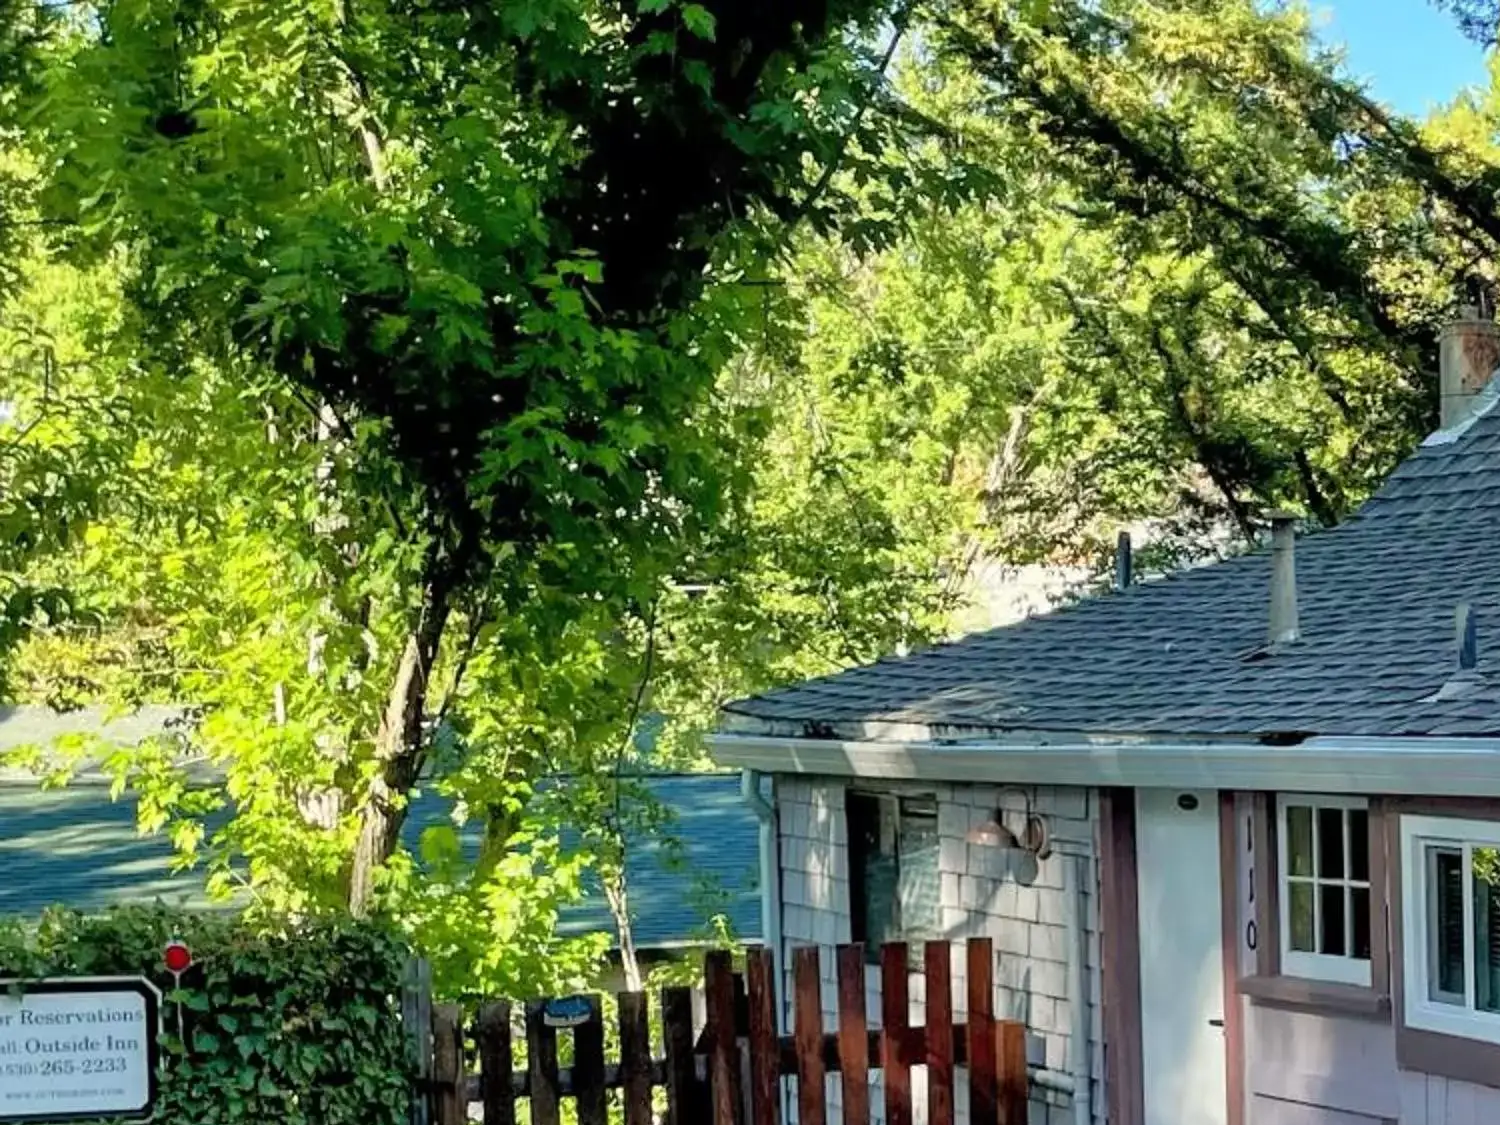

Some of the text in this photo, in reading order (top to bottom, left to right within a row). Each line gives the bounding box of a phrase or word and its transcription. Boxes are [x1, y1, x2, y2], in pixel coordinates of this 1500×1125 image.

[1246, 815, 1258, 950] 110
[20, 1008, 144, 1026] Reservations
[25, 1036, 100, 1054] Outside
[106, 1034, 139, 1051] Inn
